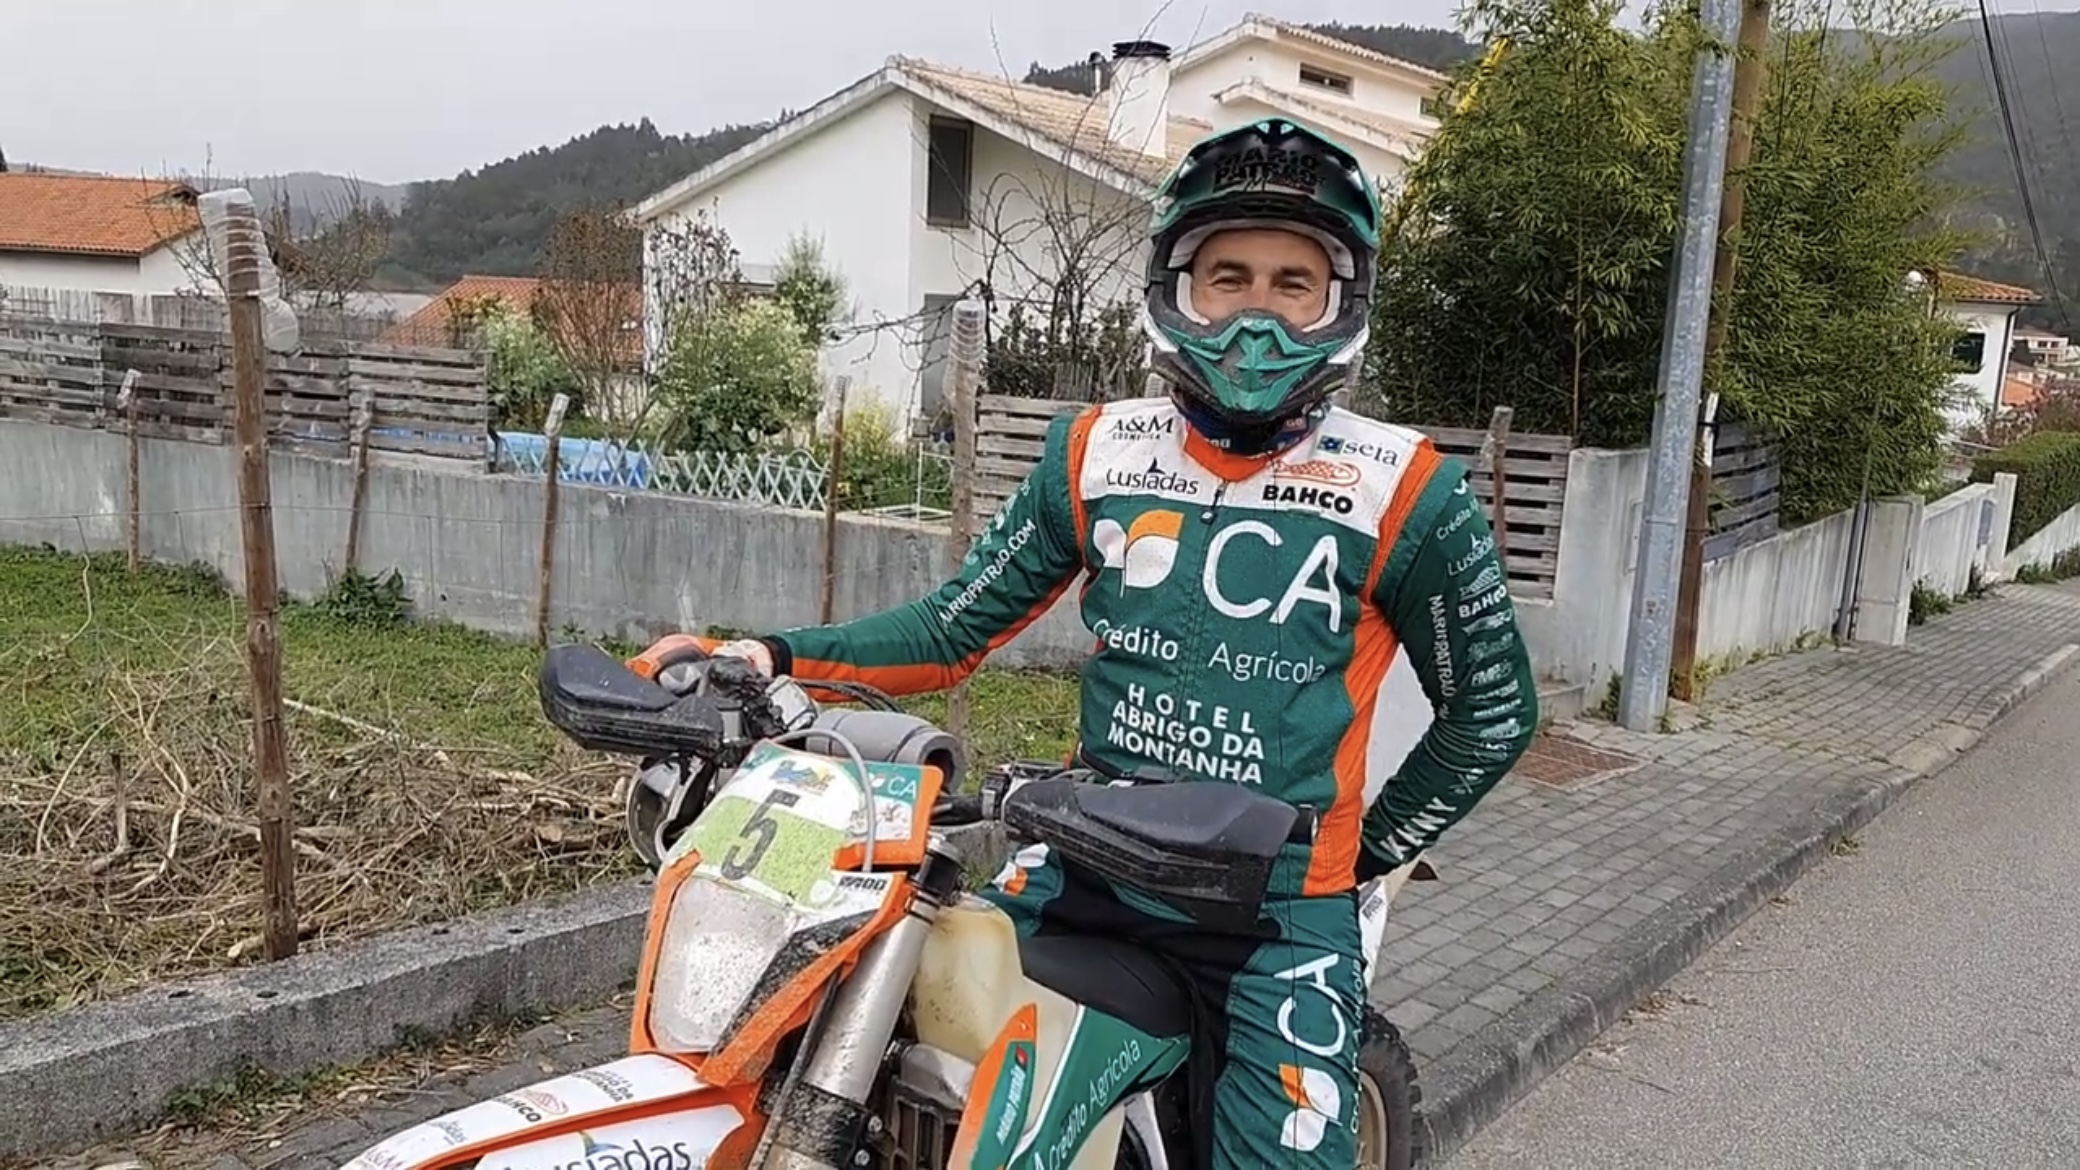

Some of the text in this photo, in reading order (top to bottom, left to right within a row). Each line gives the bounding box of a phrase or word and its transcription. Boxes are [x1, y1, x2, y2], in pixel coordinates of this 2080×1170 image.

[1106, 415, 1174, 433] A&M
[1344, 439, 1399, 467] seia
[1262, 484, 1354, 515] BAHCO
[1202, 519, 1341, 634] CA
[1093, 618, 1179, 661] Crédito
[1111, 700, 1265, 760] ABRIGO DA
[1127, 683, 1256, 734] HOTEL
[1107, 721, 1263, 784] MONTANHA
[887, 776, 917, 800] CA
[720, 788, 801, 880] 5
[1273, 952, 1347, 1057] CA
[1049, 1037, 1142, 1170] Crédito Agrícola
